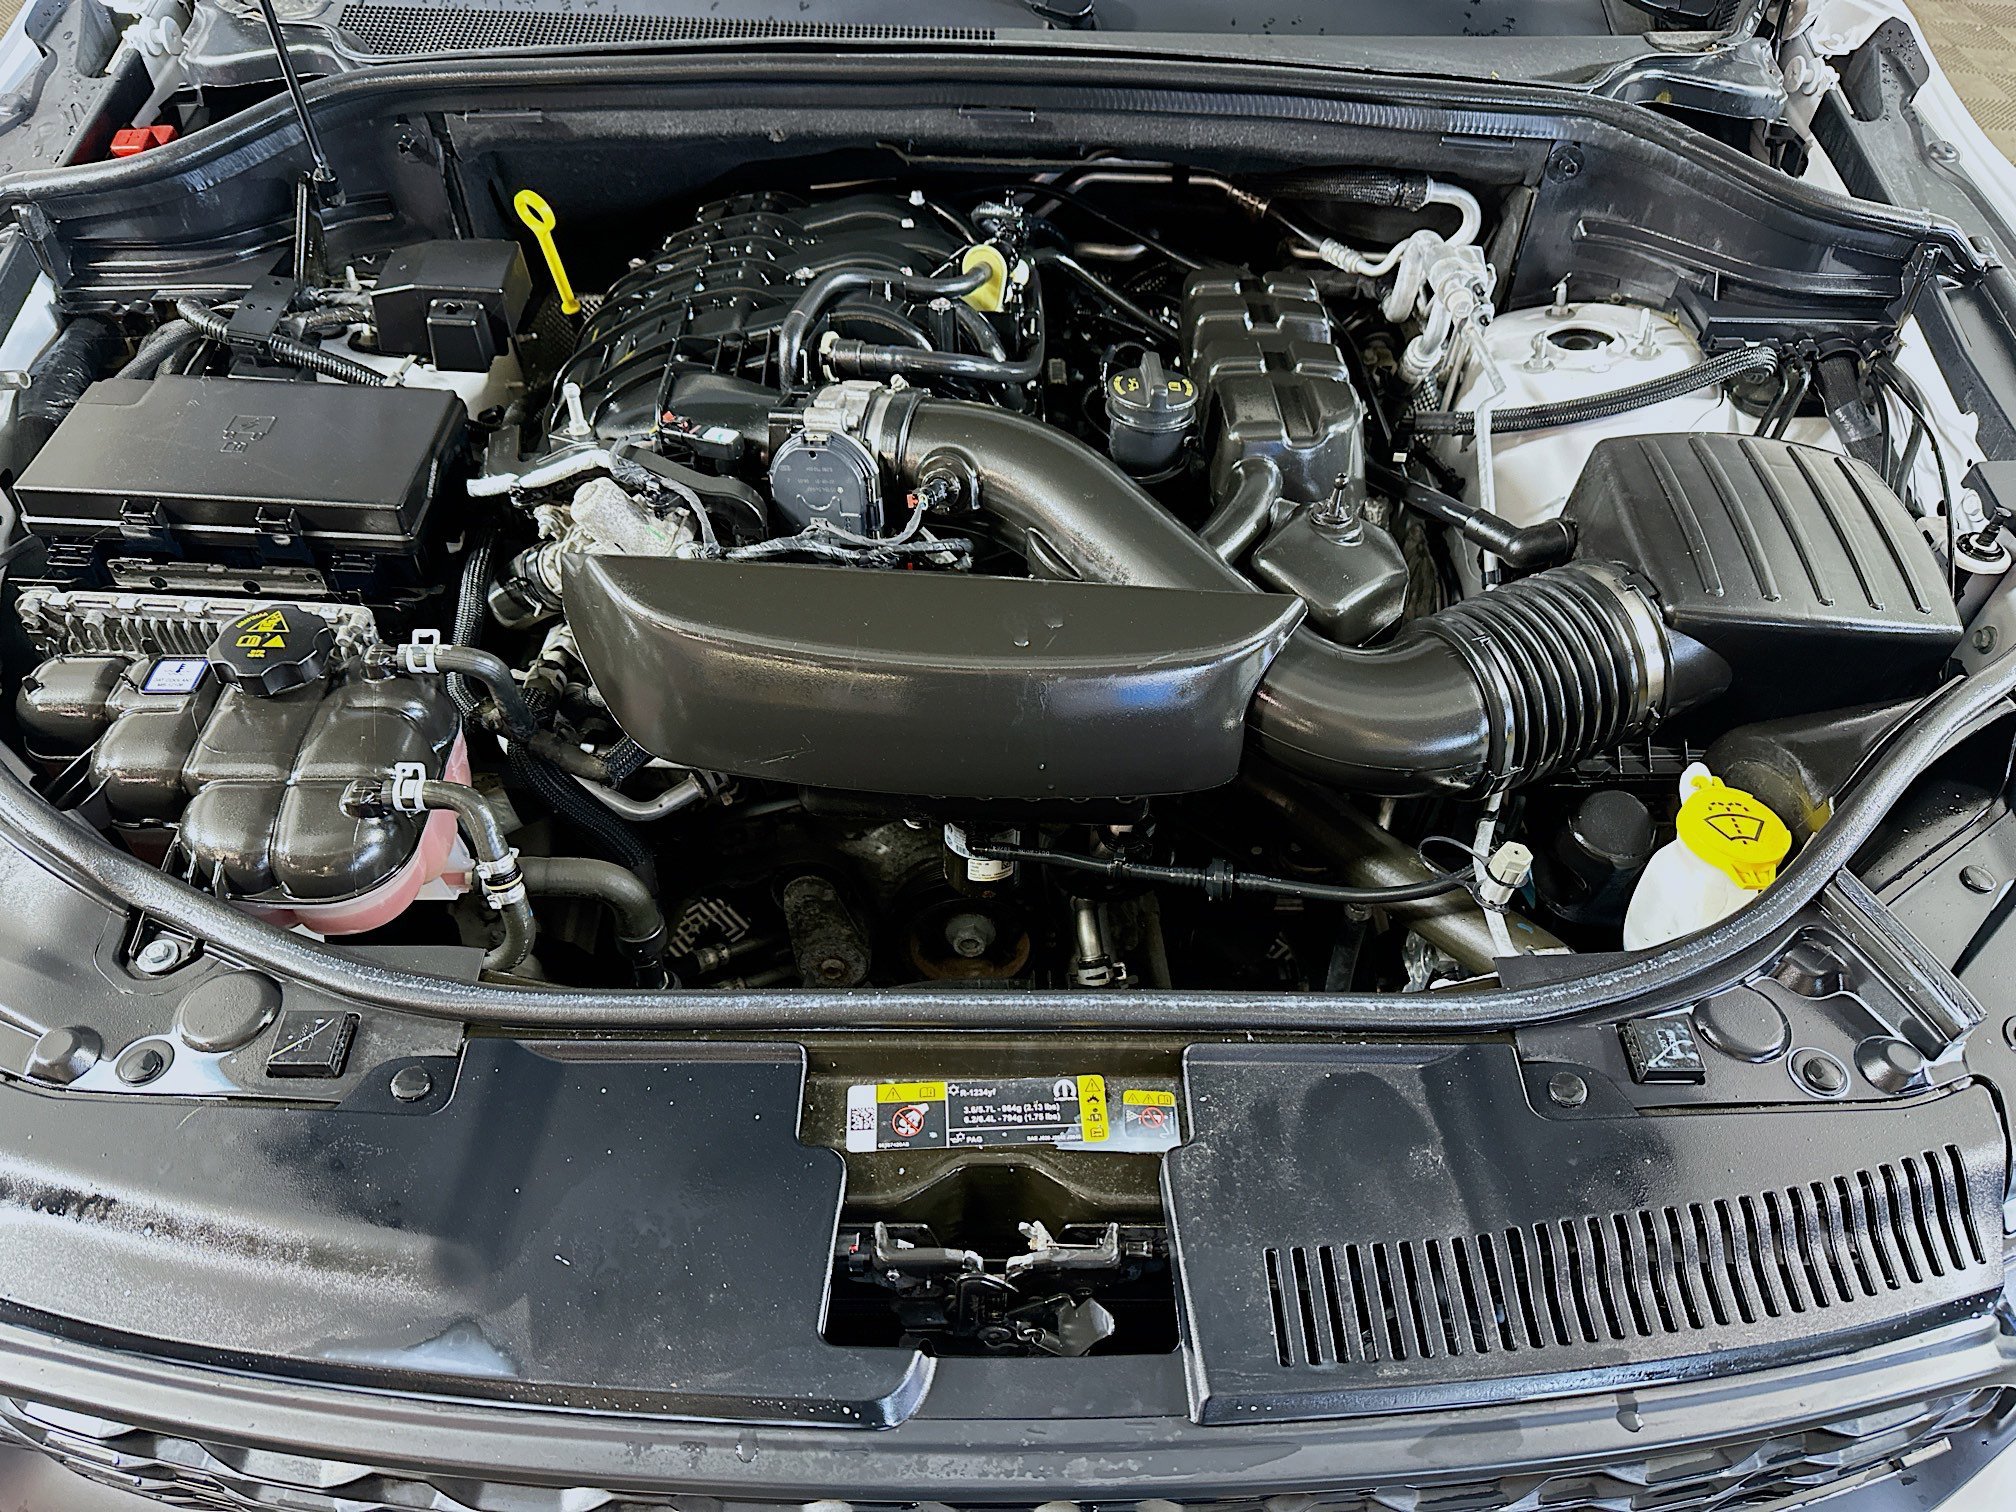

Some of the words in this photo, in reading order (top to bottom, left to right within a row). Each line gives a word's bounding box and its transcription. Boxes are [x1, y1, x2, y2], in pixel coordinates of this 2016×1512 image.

[959, 1087, 996, 1098] R-1234yf
[1023, 1102, 1044, 1113] (2.13
[1024, 1112, 1044, 1123] (1.75
